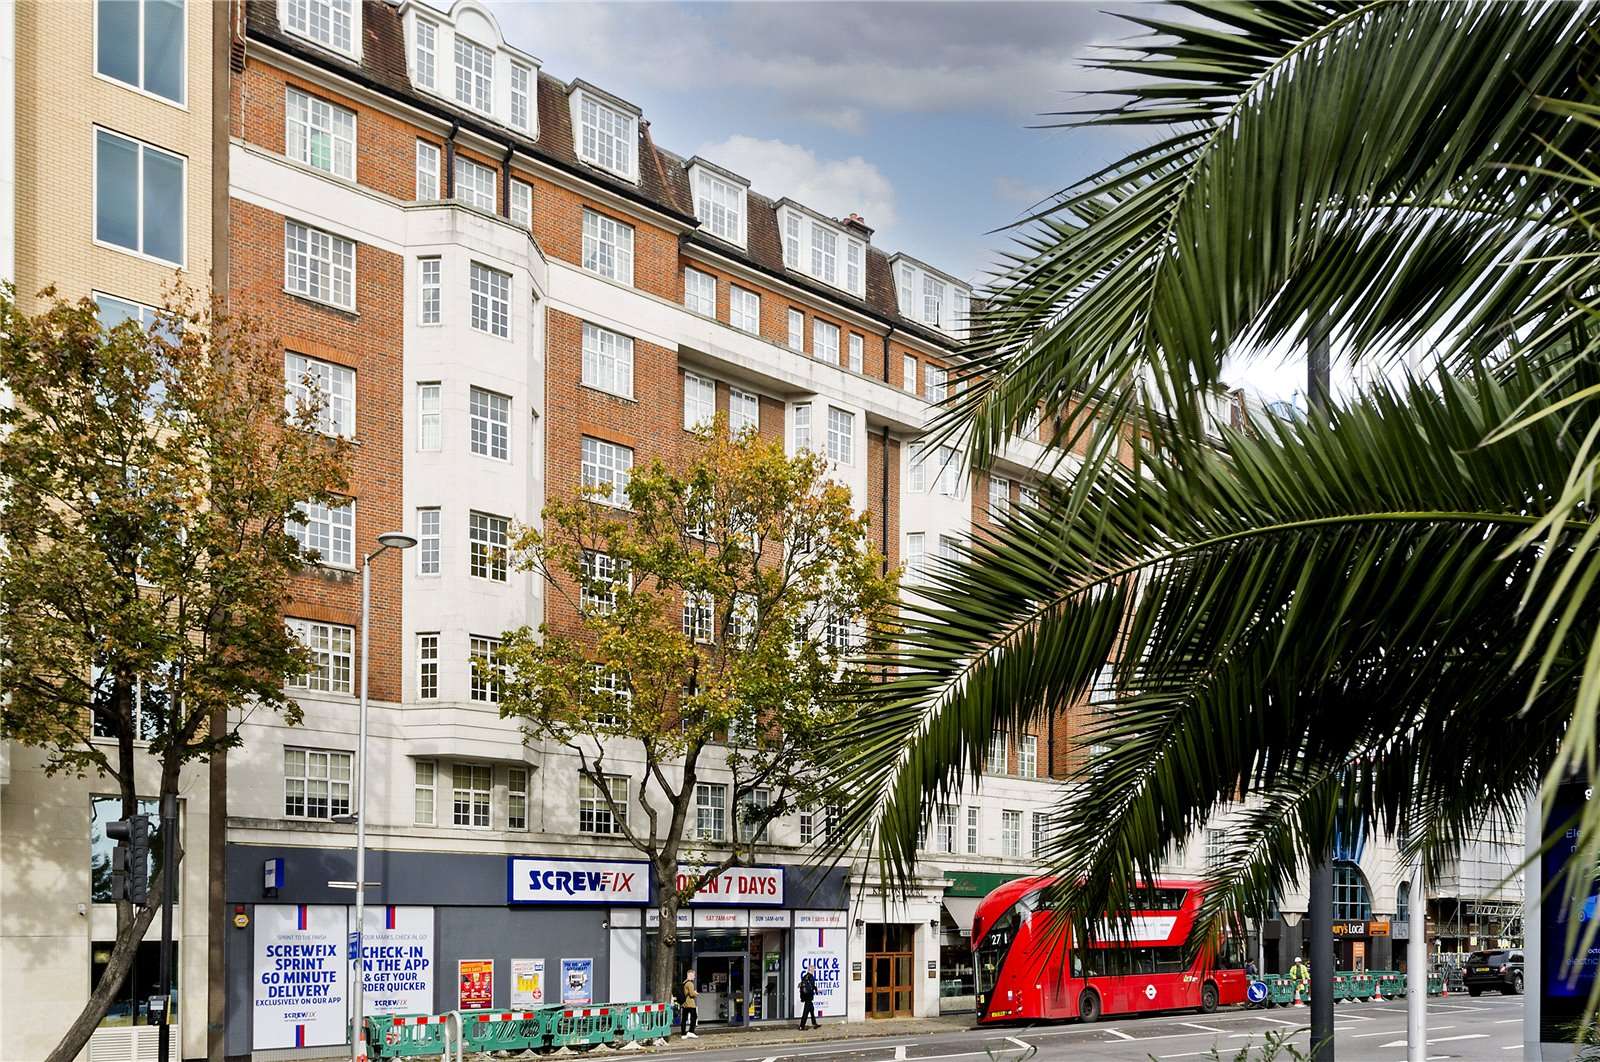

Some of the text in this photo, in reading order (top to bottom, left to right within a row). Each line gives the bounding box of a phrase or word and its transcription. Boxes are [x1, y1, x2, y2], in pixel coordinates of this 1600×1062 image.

[529, 870, 635, 896] SCREWFIX
[723, 876, 733, 894] 7
[738, 876, 777, 895] DAYS
[1349, 922, 1364, 934] Local
[991, 934, 1001, 945] 27
[266, 944, 337, 958] SCREWFIX
[362, 946, 423, 959] CHECK-IN
[275, 958, 325, 971] SPRINT
[376, 959, 401, 971] THE
[404, 958, 430, 971] APP
[802, 957, 840, 970] CLICK &
[261, 971, 337, 985] 60 MINUTE
[364, 972, 418, 982] & GET YOUR
[801, 970, 840, 981] CLLECT
[268, 984, 330, 998] DELIVERY
[362, 982, 426, 992] RDER QUICKER
[255, 998, 299, 1007] EXCLUSIVELY
